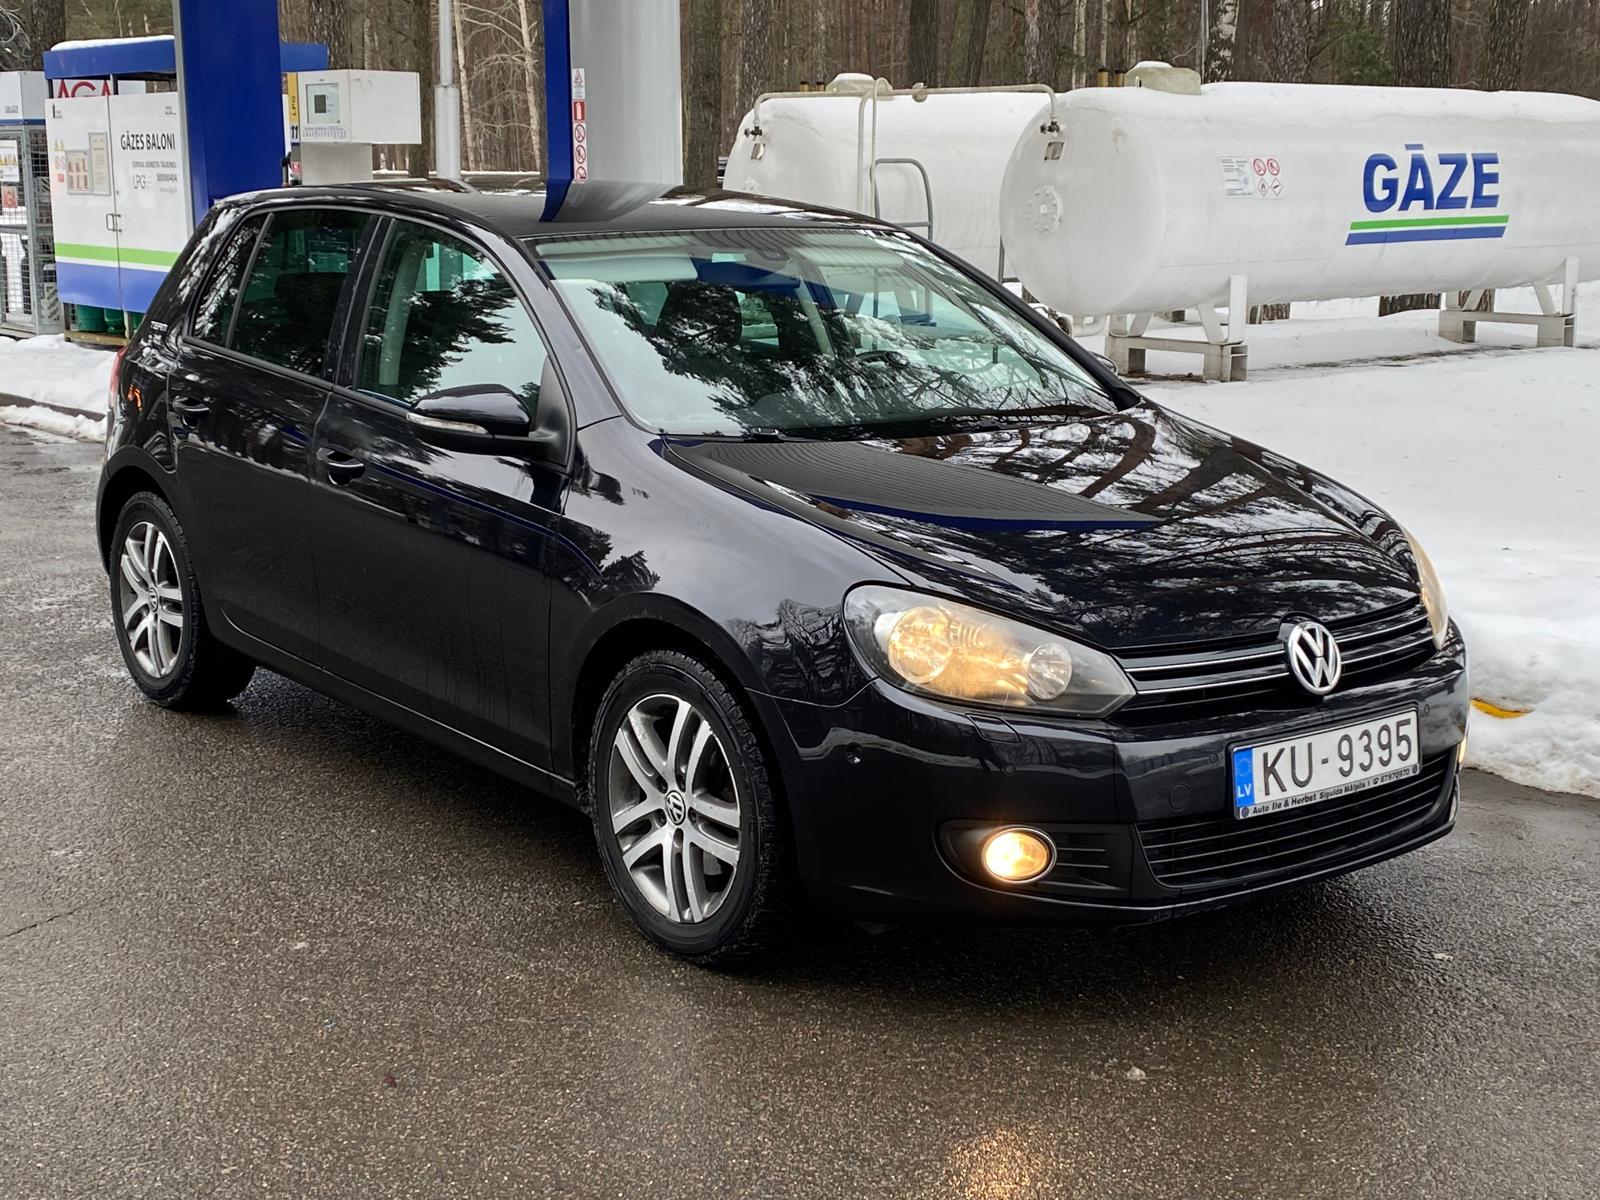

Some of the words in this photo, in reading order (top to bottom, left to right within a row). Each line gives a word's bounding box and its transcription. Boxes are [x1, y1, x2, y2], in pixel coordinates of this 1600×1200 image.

[120, 130, 144, 150] GĀZES
[146, 133, 176, 150] BALONI
[290, 125, 298, 139] 11
[1363, 143, 1500, 213] GĀZE
[1262, 718, 1412, 796] KU-9395
[1237, 783, 1251, 798] LV
[1252, 805, 1270, 815] Auto
[1283, 799, 1290, 808] &
[1291, 793, 1317, 806] Herbst
